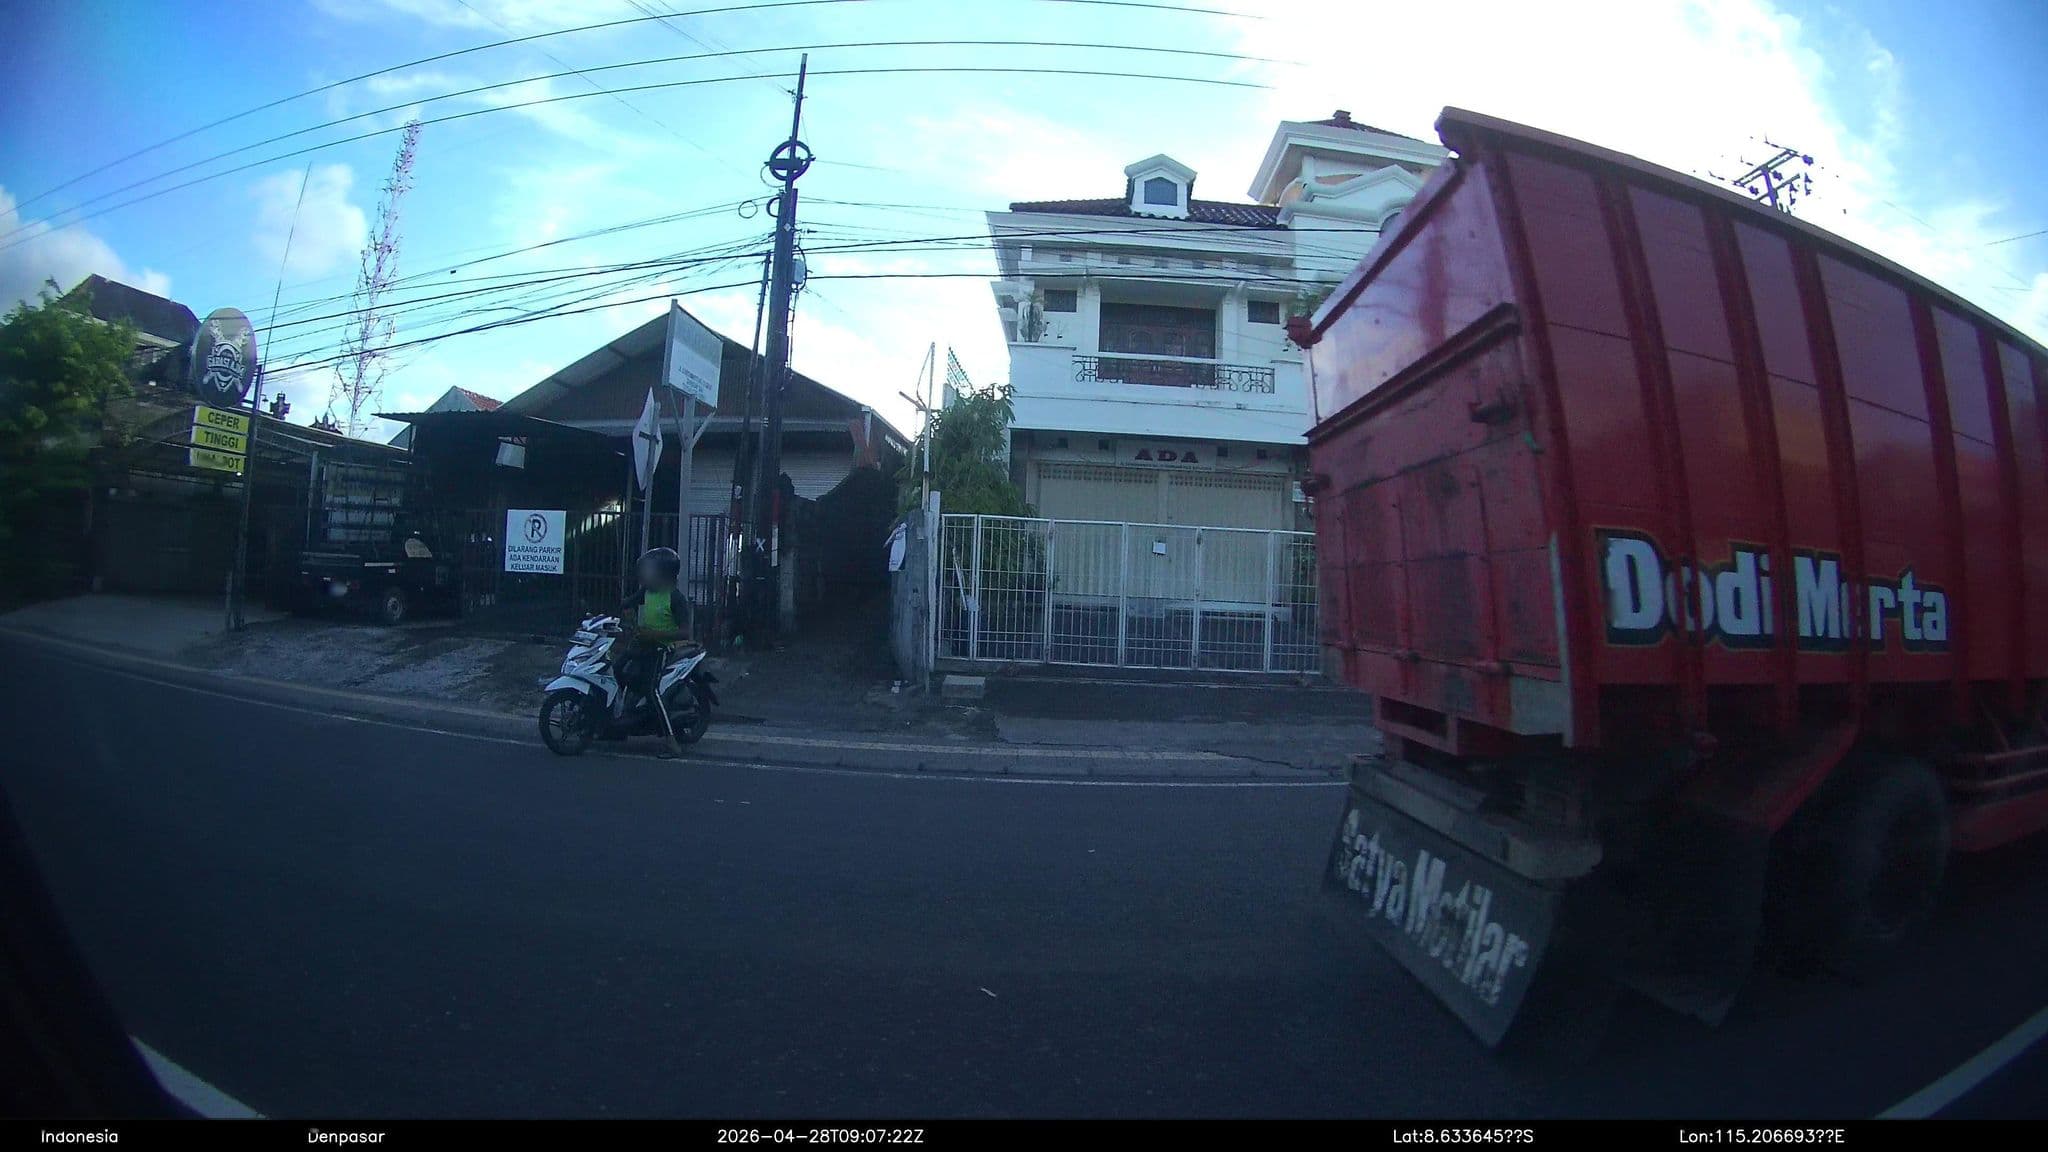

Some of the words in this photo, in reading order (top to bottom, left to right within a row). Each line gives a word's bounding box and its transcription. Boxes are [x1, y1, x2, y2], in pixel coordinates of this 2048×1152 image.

[207, 412, 240, 430] CEPER
[204, 431, 239, 449] TINGGI
[1134, 448, 1199, 463] ADA
[538, 546, 562, 554] PARKIR
[510, 554, 522, 562] ADA
[522, 554, 560, 563] KENDARAAN
[510, 563, 534, 571] KELUAR
[535, 564, 558, 572] MASUK
[1603, 536, 1774, 636] Dodi
